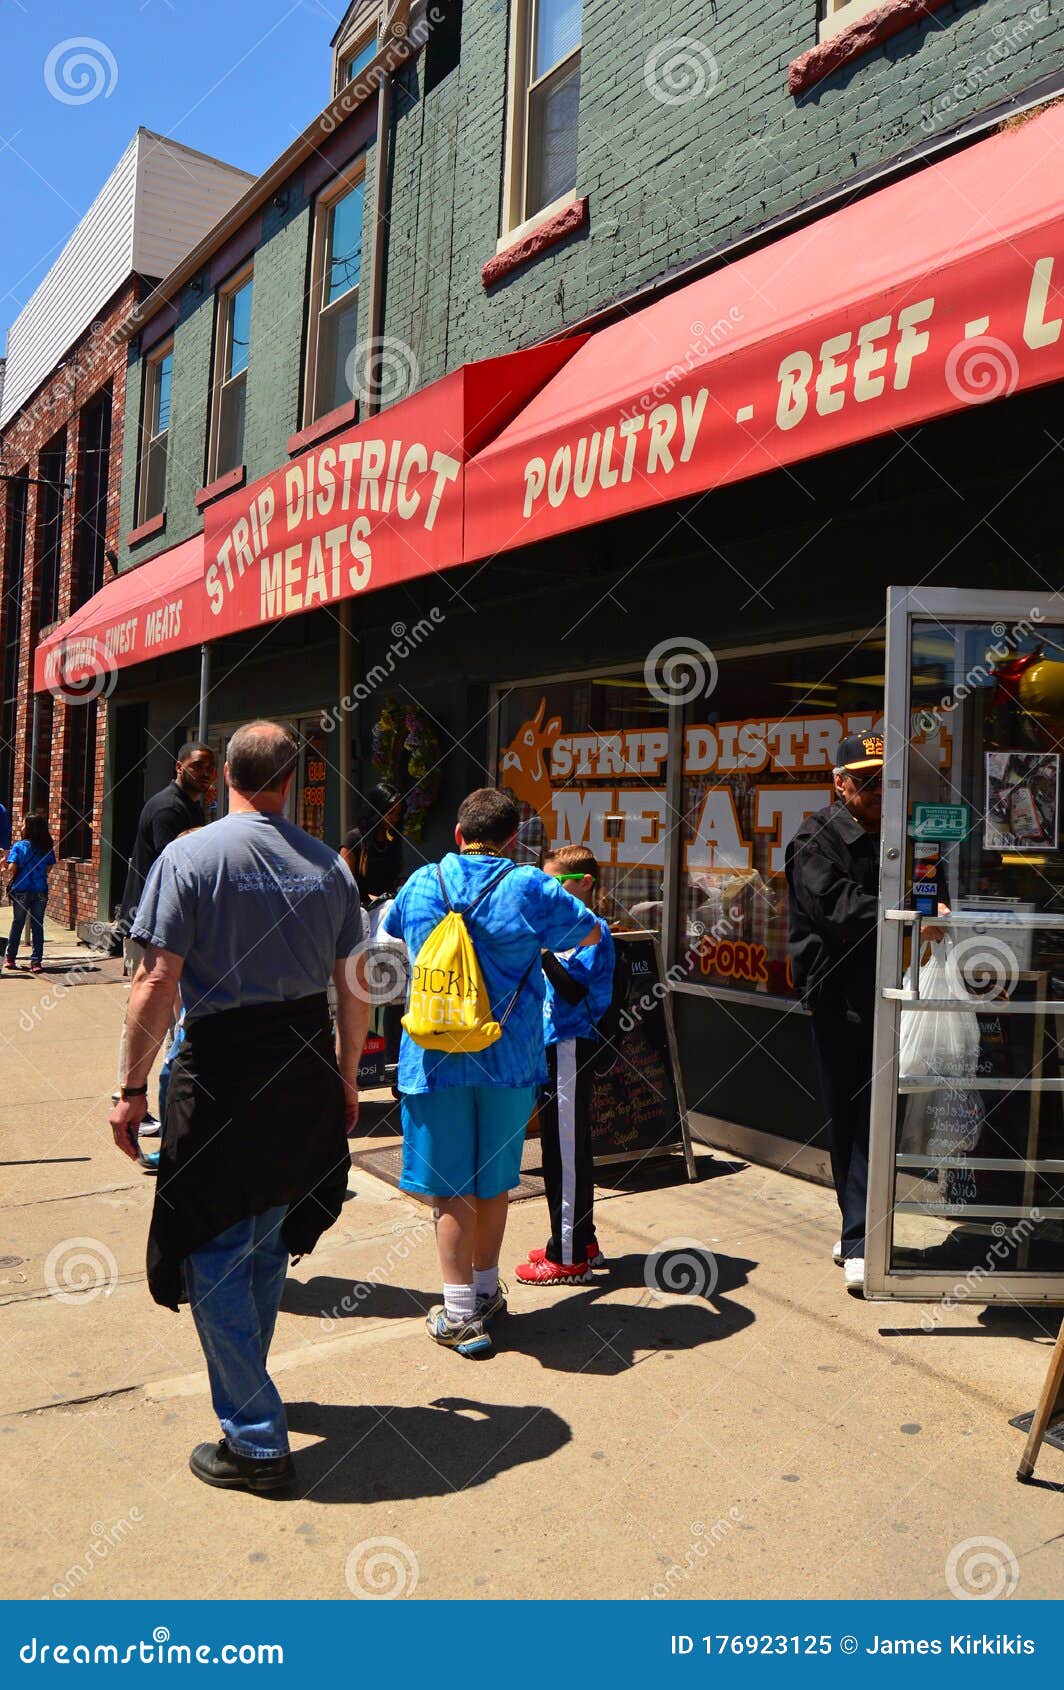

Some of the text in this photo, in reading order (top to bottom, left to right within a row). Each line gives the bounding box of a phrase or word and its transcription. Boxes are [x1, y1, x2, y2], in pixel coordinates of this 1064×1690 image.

[522, 387, 709, 518] POULTRY
[775, 297, 935, 431] BEEF
[204, 439, 462, 616] STRIP DISTRICT
[259, 515, 372, 621] MEATS
[104, 616, 139, 659] FINEST
[144, 599, 184, 648] MEATS
[548, 729, 668, 780] STRIP
[915, 884, 936, 893] VISA
[412, 965, 462, 997] PICK
[700, 940, 769, 982] PORK
